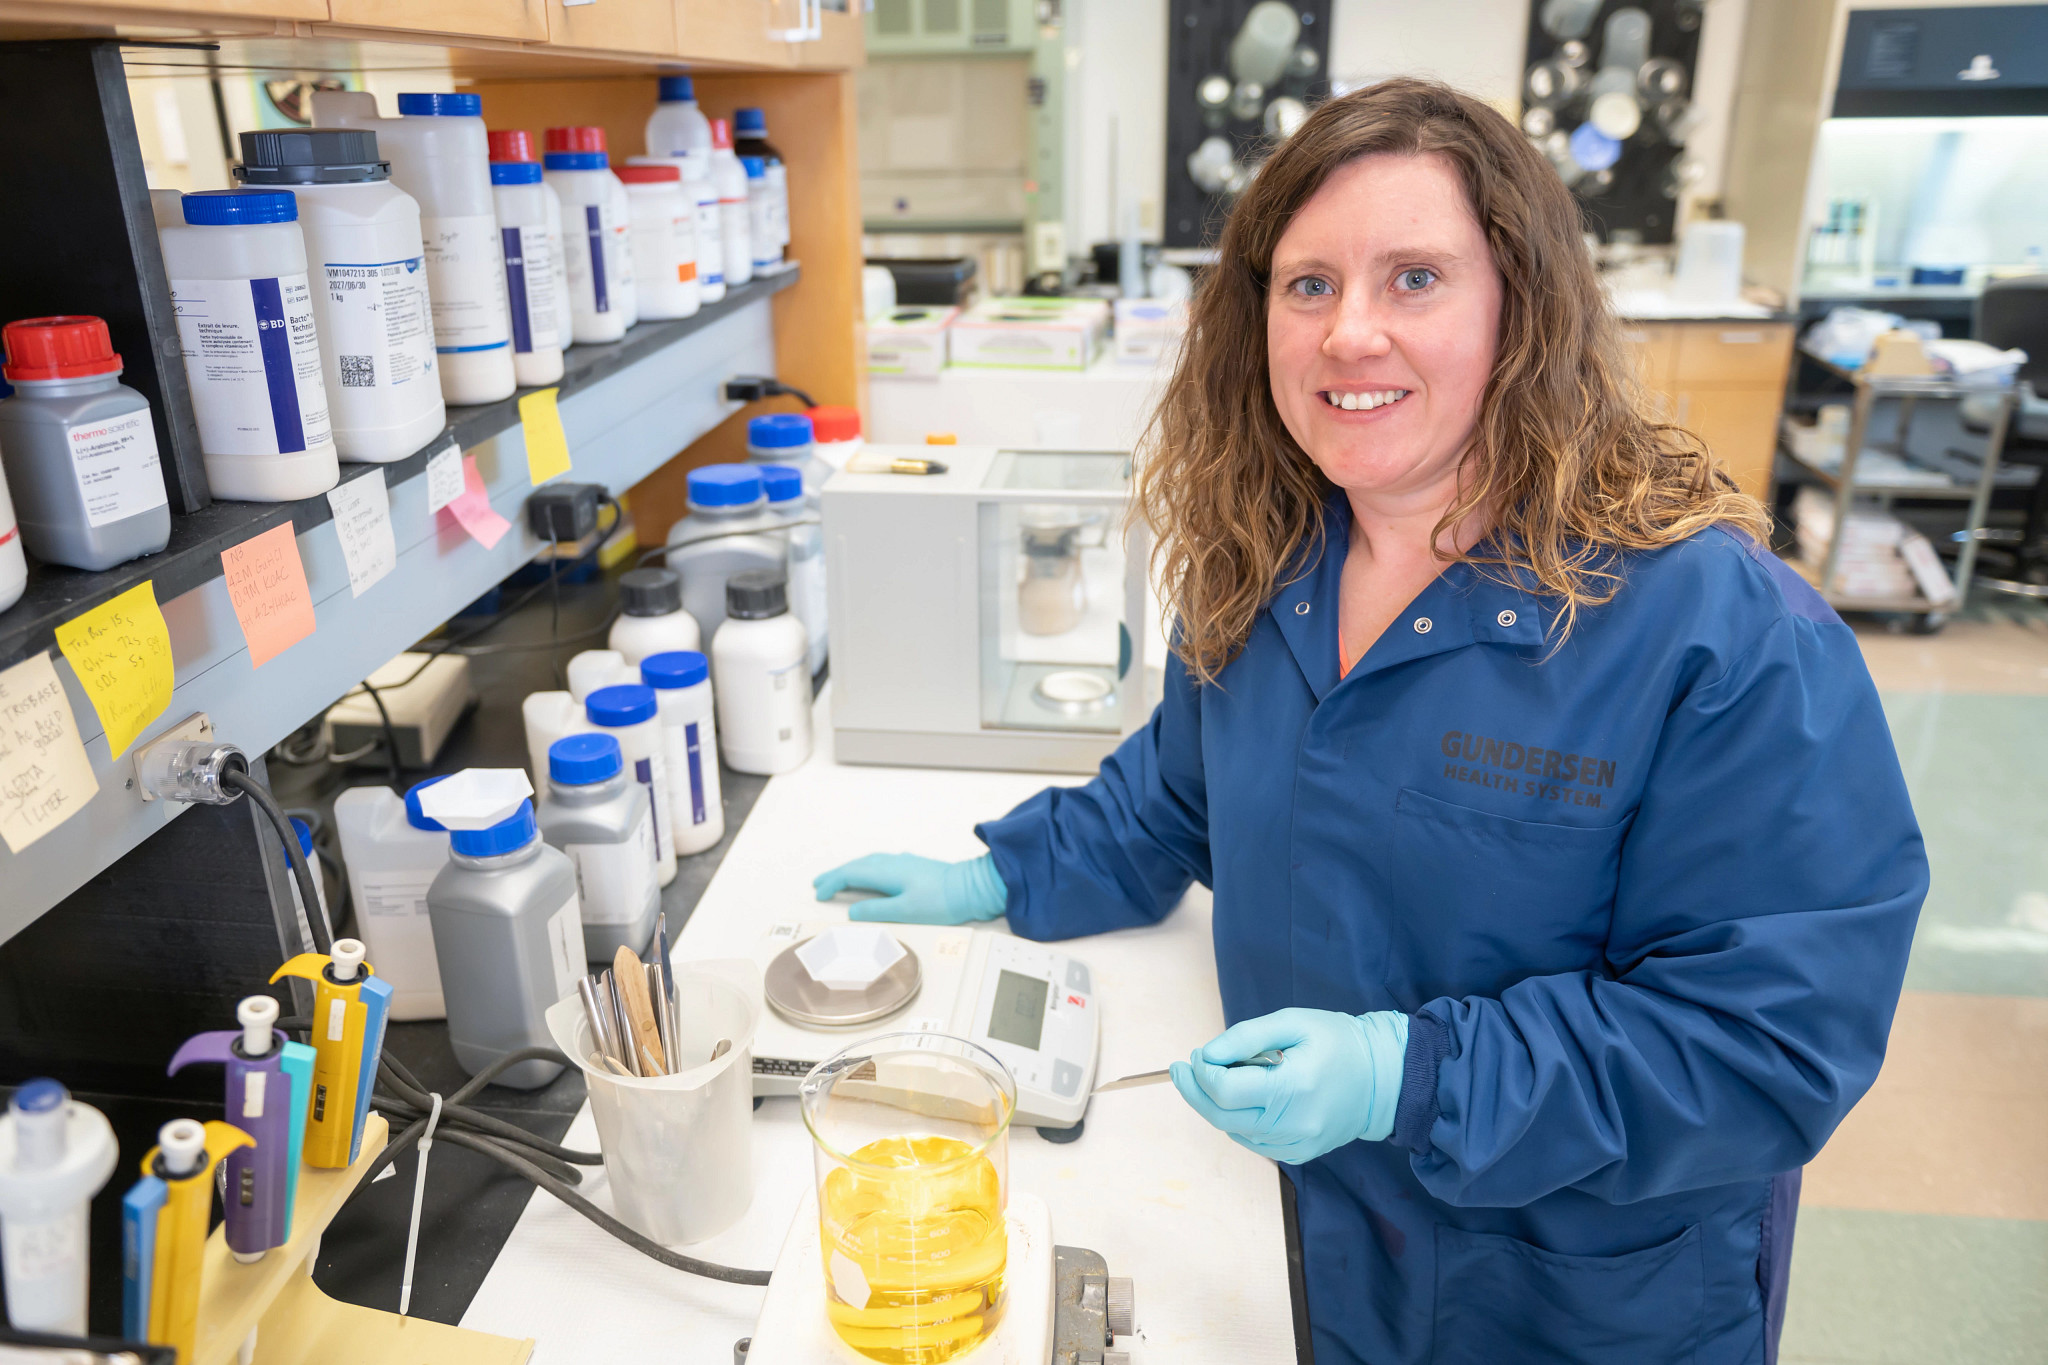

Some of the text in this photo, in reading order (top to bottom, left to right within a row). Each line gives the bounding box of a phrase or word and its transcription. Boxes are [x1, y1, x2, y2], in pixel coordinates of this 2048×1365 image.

[367, 269, 378, 278] 305
[329, 280, 366, 290] 2027/06/30
[336, 293, 343, 302] kg
[270, 319, 285, 329] BD
[72, 427, 107, 442] thermo
[1441, 730, 1617, 788] GUNDERSEN
[1443, 763, 1602, 809] HEALTH SYSTEM
[930, 1249, 951, 1260] 500
[932, 1294, 952, 1304] 300
[933, 1315, 953, 1326] 200
